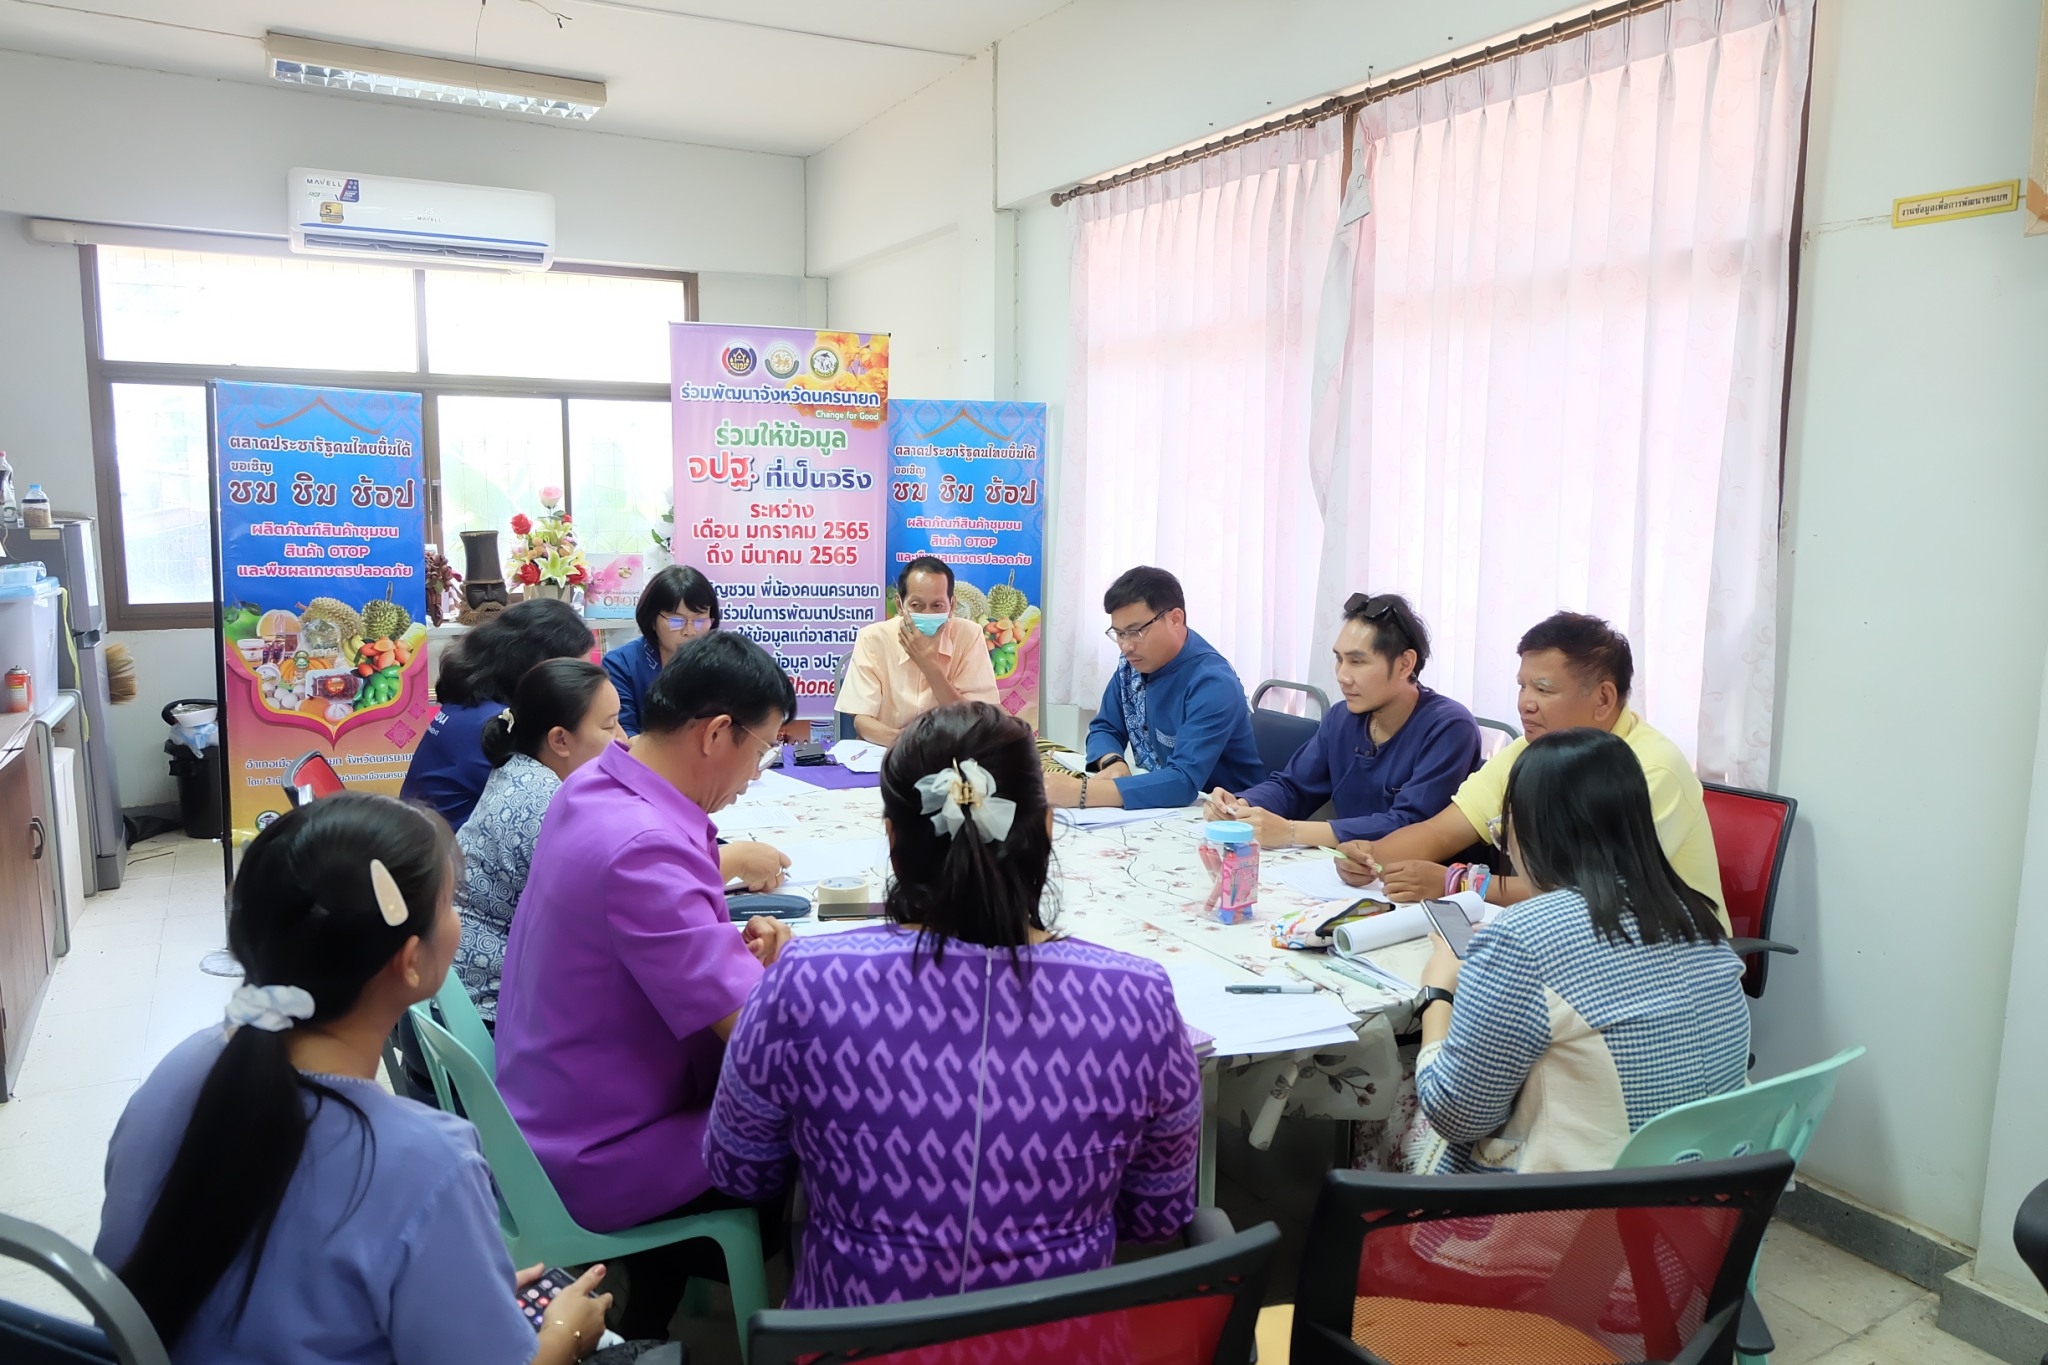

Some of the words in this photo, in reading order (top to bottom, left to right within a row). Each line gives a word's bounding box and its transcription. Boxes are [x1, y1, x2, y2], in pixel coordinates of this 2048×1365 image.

[306, 178, 342, 188] MAVELL
[325, 204, 332, 214] 5
[681, 382, 880, 406] ร่วมพัฒนาจังหวัดนครนายก
[815, 410, 845, 422] Change
[846, 411, 858, 420] for
[859, 412, 879, 421] Good
[230, 436, 412, 457] ตลาดประชารัฐคนไทยยิ้มได้
[716, 421, 847, 456] ร่วมให้ข้อมูล
[895, 443, 1036, 461] ตลาดประชารัฐคนไทยยิ้มได้
[230, 459, 272, 475] ขอเชิญ
[688, 451, 756, 488] จปฐ.
[766, 458, 873, 489] ที่เป็นจริง
[895, 464, 926, 477] ขอเชิญ
[230, 480, 276, 504] ชม
[292, 472, 336, 505] ชิม
[352, 475, 414, 508] ช้อป
[893, 482, 927, 502] ชม
[939, 475, 973, 503] ชิม
[985, 476, 1037, 504] ช้อป
[750, 498, 815, 518] ระหว่าง
[251, 522, 398, 541] ผลิตภัณฑ์สินค้าชุมชน
[693, 518, 739, 538] เดือน
[746, 523, 817, 539] มกราคม
[823, 521, 870, 540] 2565
[907, 517, 1022, 533] ผลิตภัณฑ์สินค้าชุมชน
[930, 535, 961, 547] สินค้า
[965, 537, 997, 547] OTOP
[284, 543, 324, 558] สินค้า
[328, 546, 369, 558] OTOP
[706, 543, 734, 565] ถึง
[741, 543, 802, 564] มีนาคม
[809, 546, 858, 565] 2565
[238, 562, 412, 578] และพืชผลเกษตรปลอดภัย
[761, 575, 879, 597] พี่น้องคนนครนายก
[720, 604, 874, 621] ร่วมในการพัฒนาประเทศ
